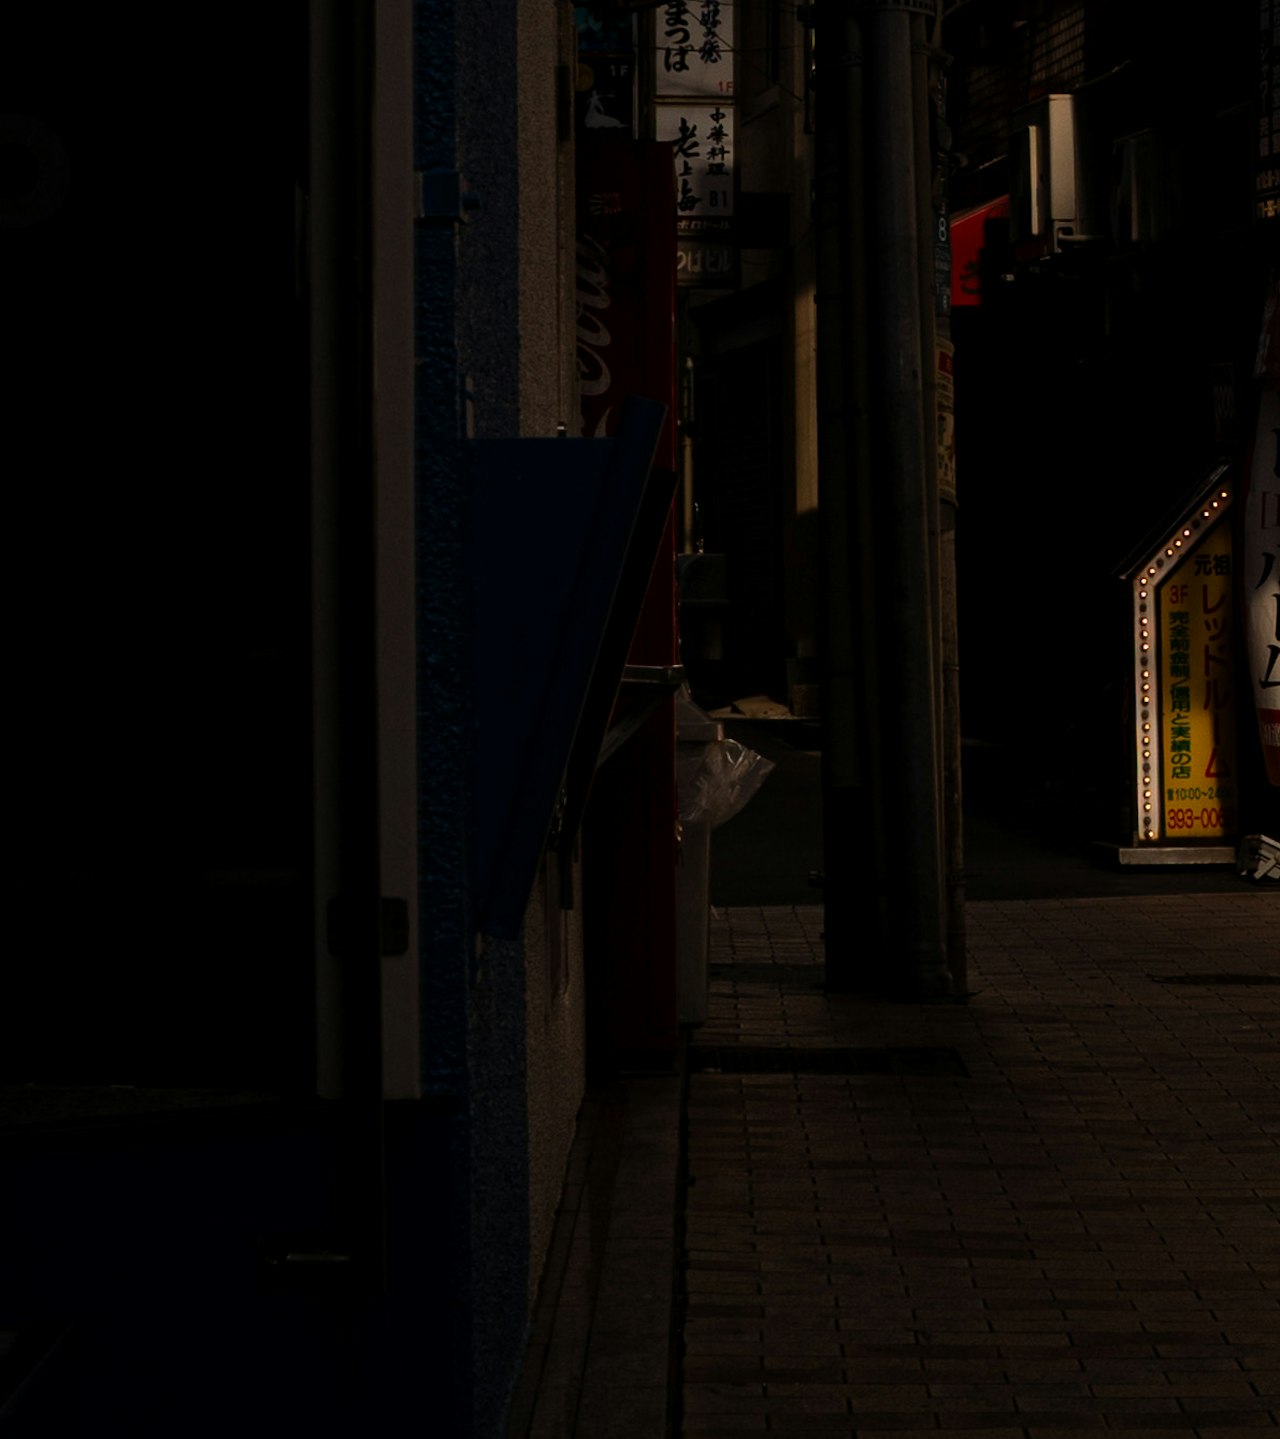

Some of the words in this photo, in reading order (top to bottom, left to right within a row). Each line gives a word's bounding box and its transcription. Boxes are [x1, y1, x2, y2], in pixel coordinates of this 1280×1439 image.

[709, 190, 728, 208] B1
[1195, 554, 1231, 576] 元祖
[1169, 585, 1190, 604] 3F
[1202, 583, 1232, 778] レッドルーム
